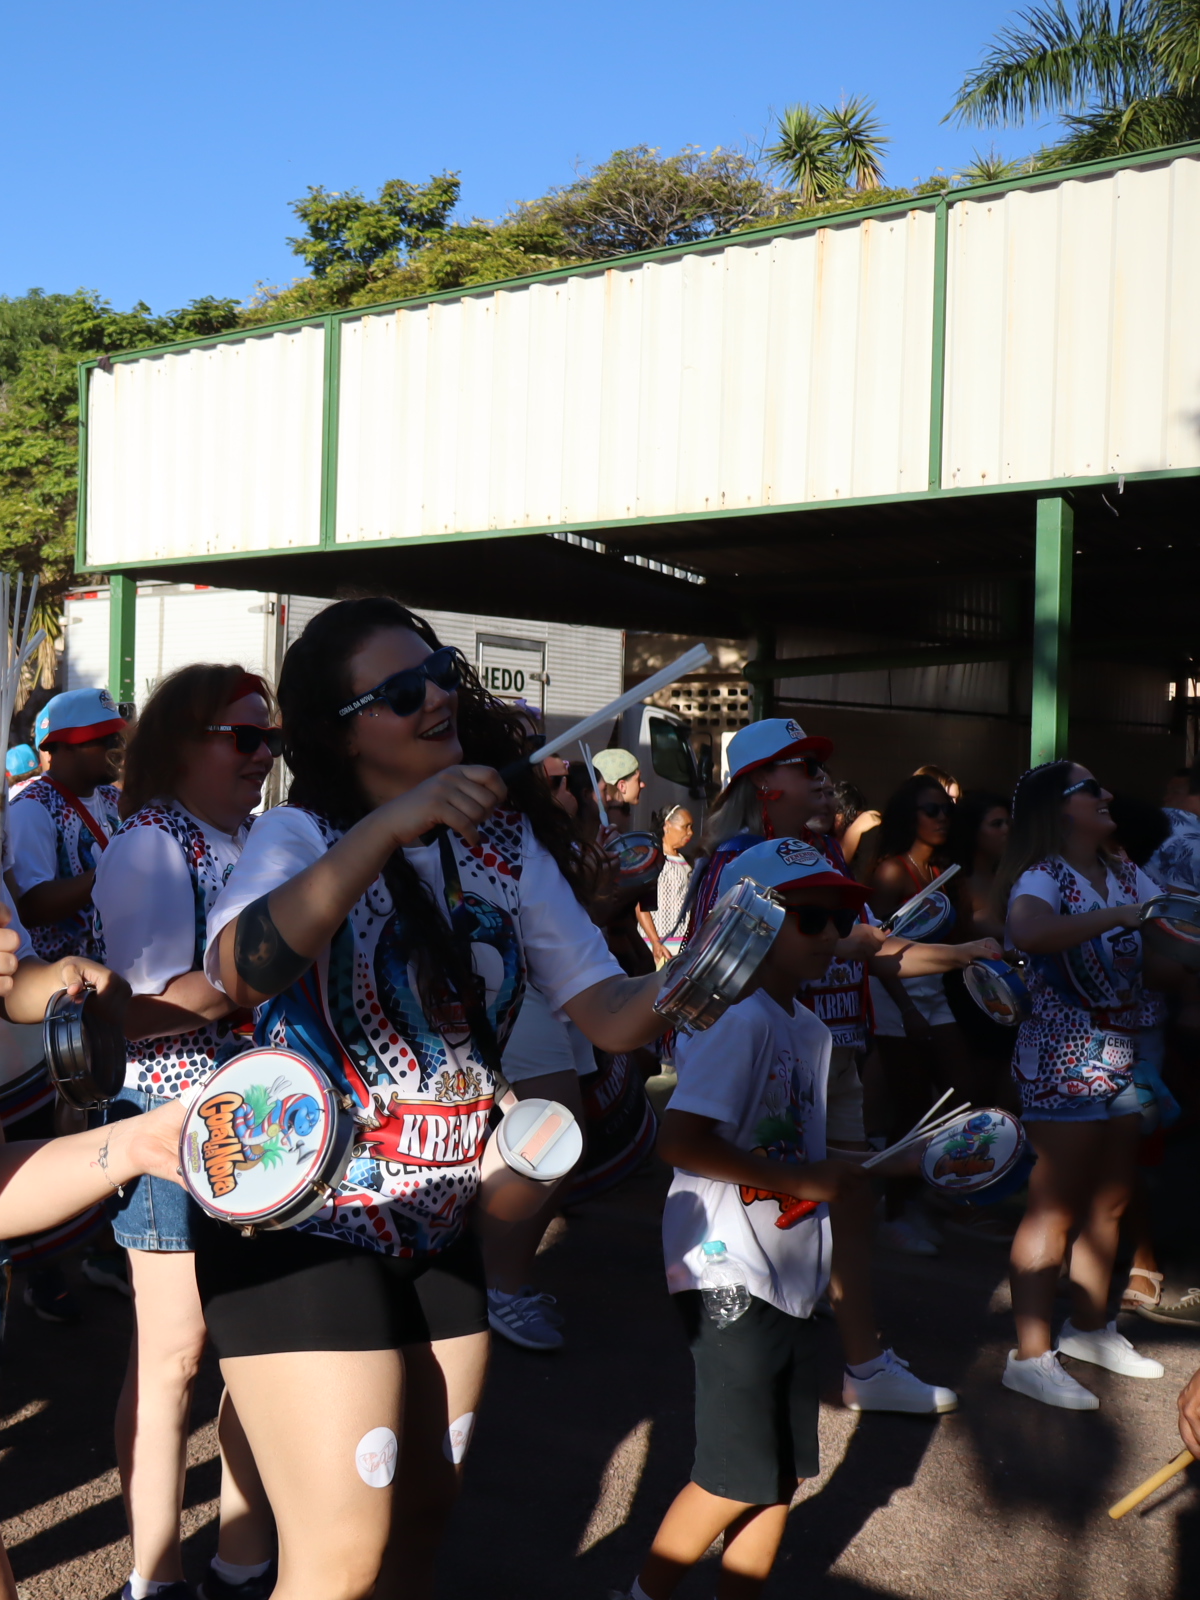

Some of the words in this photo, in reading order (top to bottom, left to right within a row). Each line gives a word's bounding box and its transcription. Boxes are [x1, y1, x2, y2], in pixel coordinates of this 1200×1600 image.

[339, 704, 355, 716] CORAL
[352, 700, 361, 709] DA
[360, 693, 375, 704] NOVA
[197, 1091, 244, 1147] Coral
[205, 1143, 247, 1199] Nova
